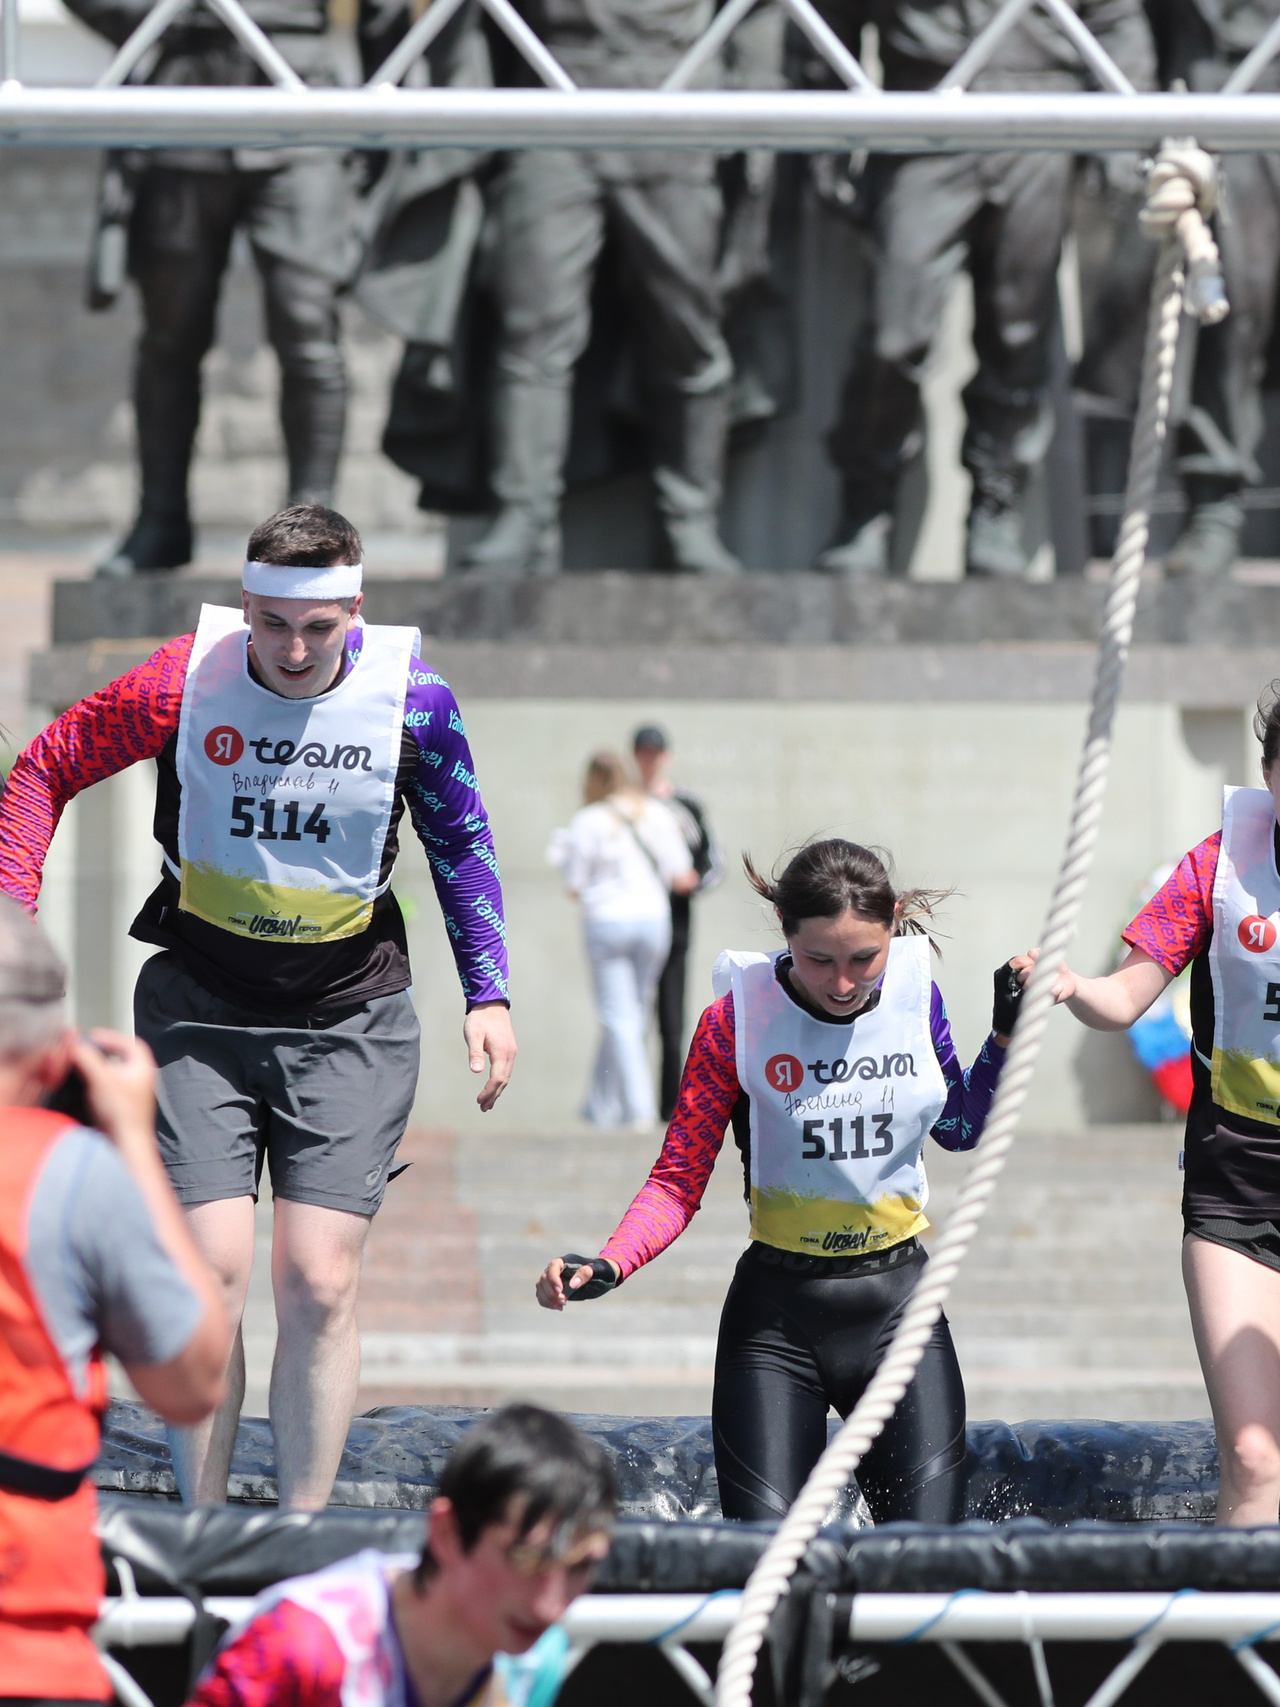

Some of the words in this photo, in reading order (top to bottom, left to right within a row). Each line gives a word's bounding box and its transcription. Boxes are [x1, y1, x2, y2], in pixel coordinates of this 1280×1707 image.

[405, 707, 433, 727] dex
[249, 737, 372, 771] team
[230, 795, 331, 843] 5114
[1167, 879, 1189, 919] ndex
[249, 915, 302, 937] URBAN
[807, 1052, 918, 1085] team
[671, 1123, 698, 1151] dex
[802, 1113, 894, 1161] 5113
[821, 1226, 872, 1253] URBAN
